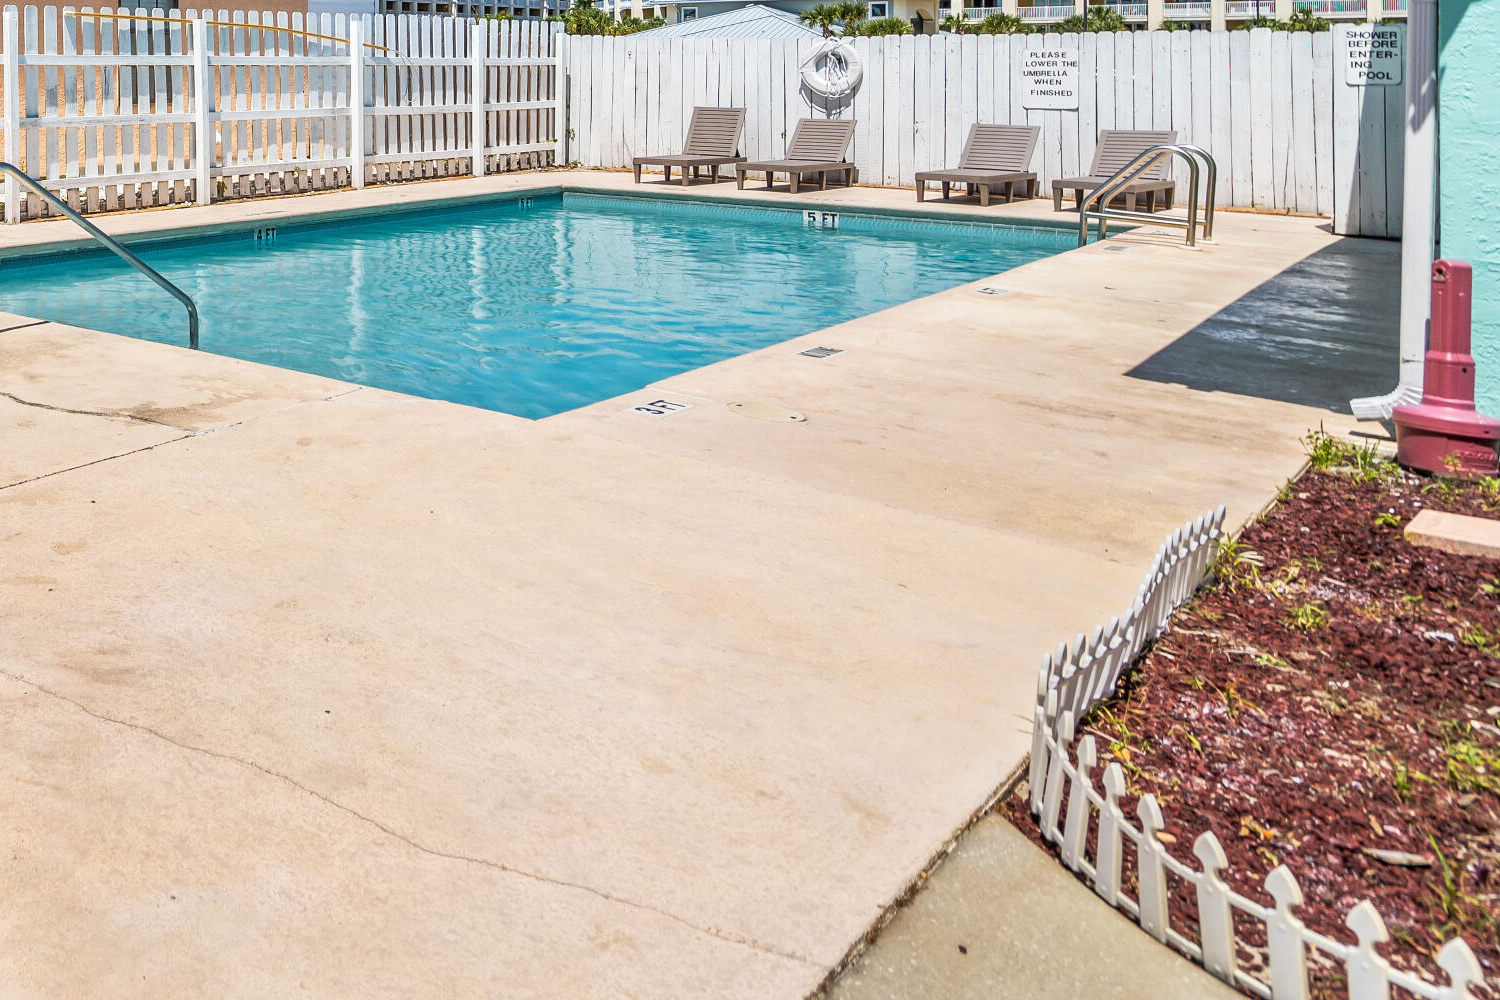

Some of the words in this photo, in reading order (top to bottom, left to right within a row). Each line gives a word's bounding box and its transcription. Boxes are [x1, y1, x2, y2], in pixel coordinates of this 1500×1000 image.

[1346, 31, 1398, 40] SHOWER
[1348, 40, 1399, 49] BEFORE
[1030, 51, 1067, 59] PLEASE
[1349, 50, 1399, 59] ENTER-
[1025, 60, 1058, 68] LOWER
[1061, 60, 1078, 68] THE
[1350, 60, 1373, 69] ING
[1358, 71, 1393, 80] POOL
[1033, 78, 1062, 86] WHEN
[1030, 89, 1073, 97] FINISHED
[807, 212, 816, 224] 5
[821, 212, 838, 227] FT
[256, 228, 263, 240] 4
[265, 227, 276, 241] FT
